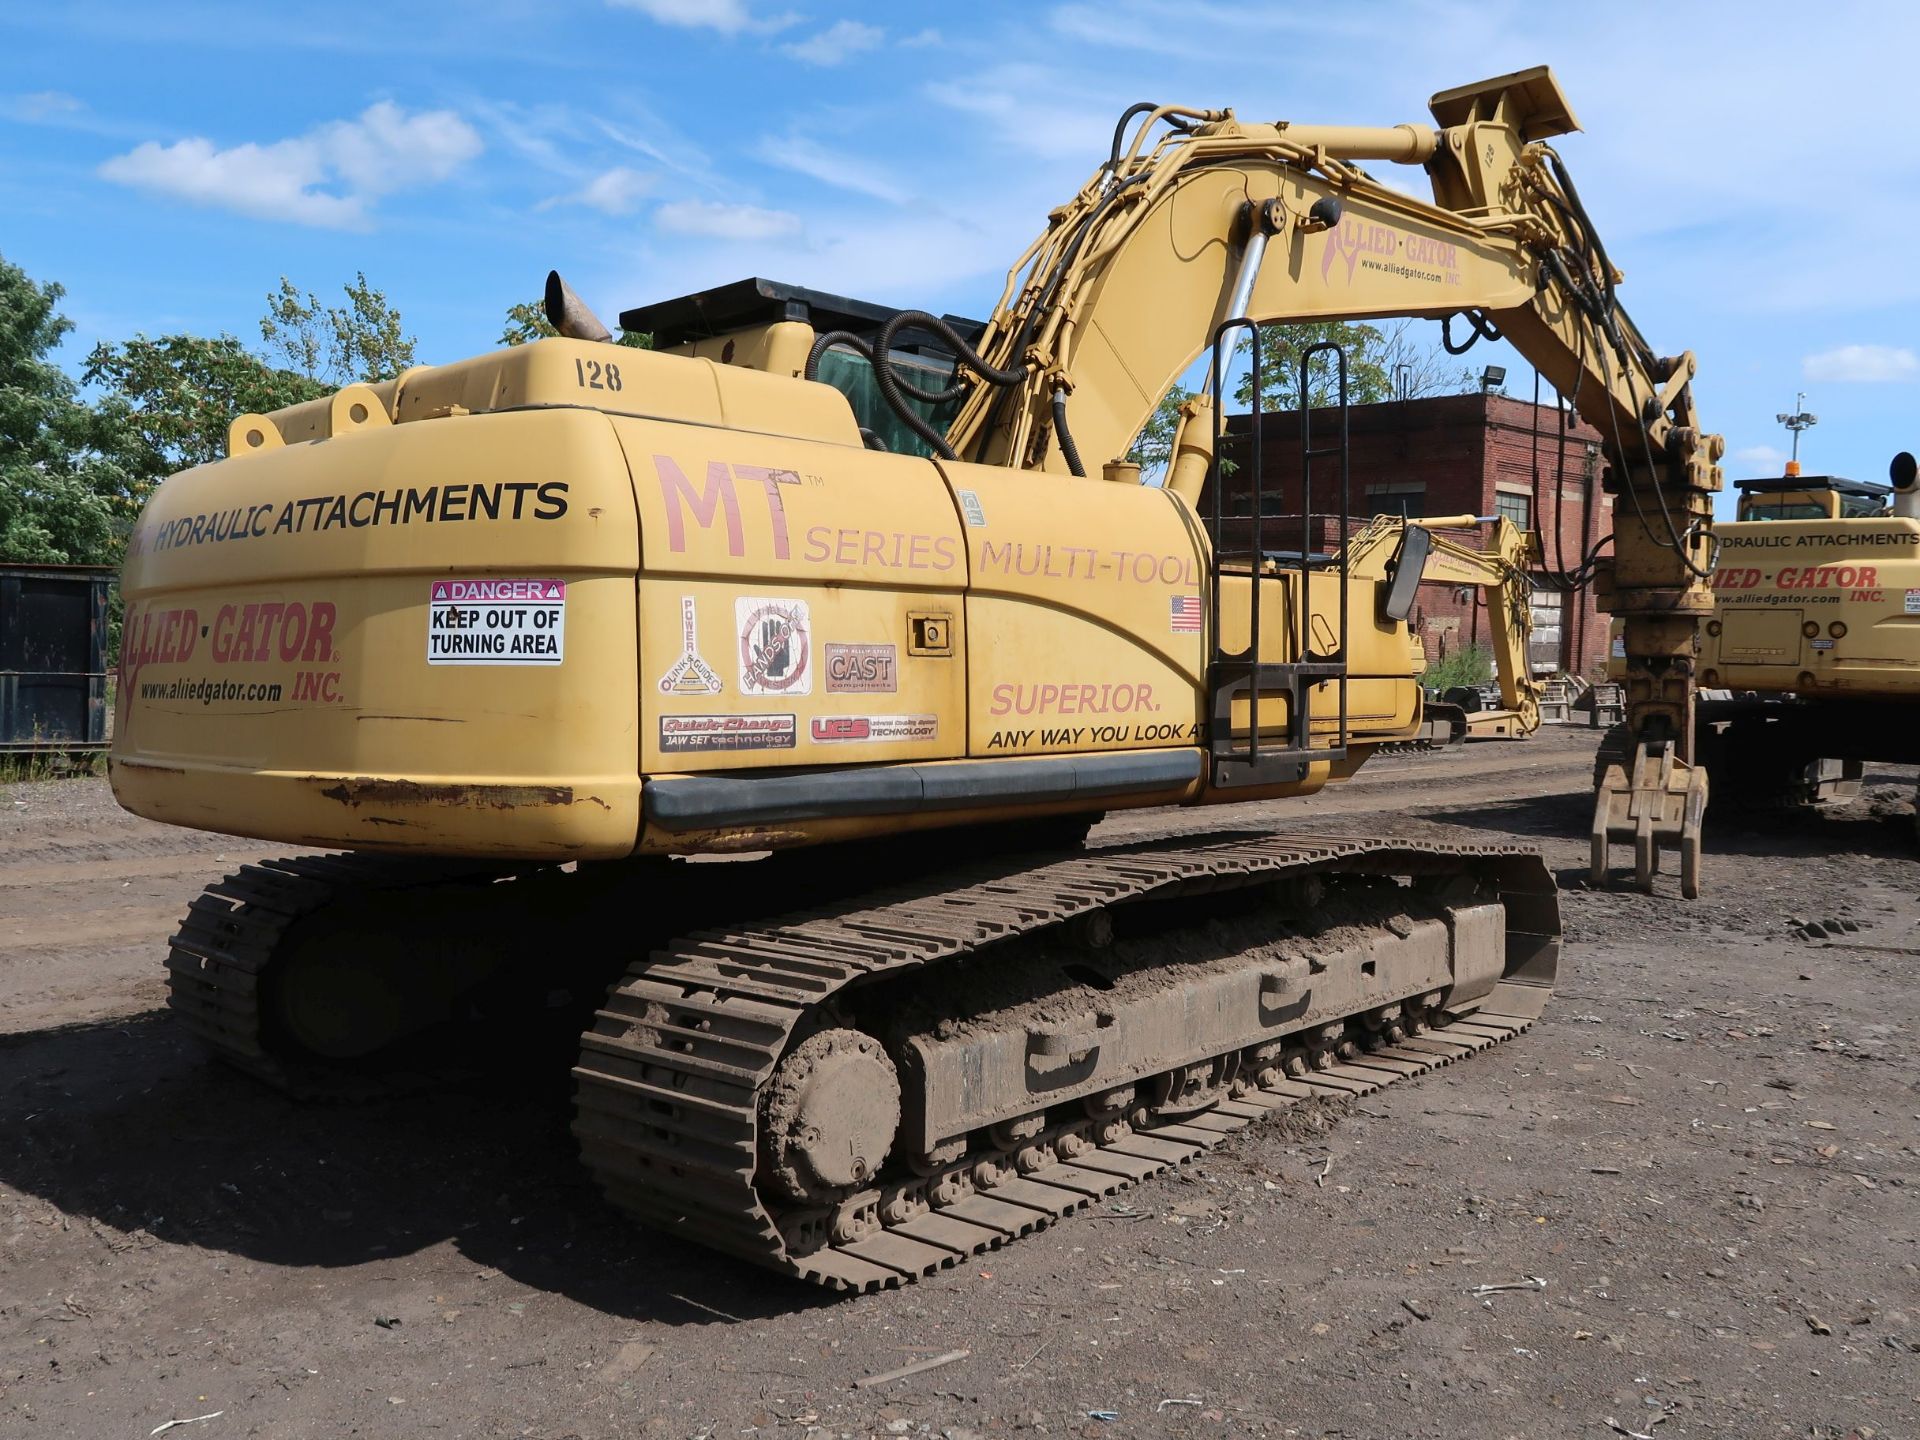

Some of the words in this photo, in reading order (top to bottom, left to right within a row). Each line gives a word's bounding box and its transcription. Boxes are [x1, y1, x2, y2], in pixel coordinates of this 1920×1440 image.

[1361, 258, 1442, 284] www.alliedgator.com
[576, 358, 622, 391] 128
[152, 503, 273, 552] HYDRAULIC
[272, 481, 569, 535] ATTACHMENTS
[652, 454, 801, 560] MT
[1720, 536, 1791, 548] DRAULIC
[1796, 533, 1919, 547] ATTACHMENTS
[804, 526, 957, 571] SERIES
[979, 540, 1201, 587] MULTI-TOOL
[1776, 567, 1877, 589] GATOR
[451, 582, 543, 600] DANGER
[1715, 594, 1840, 605] ww.alliedgator.com
[1850, 590, 1886, 602] INC.
[432, 610, 480, 629] KEEP
[486, 610, 527, 629] OUT
[533, 610, 560, 628] OF
[684, 600, 694, 651] POWER
[431, 634, 505, 654] TURNING
[510, 634, 558, 654] AREA
[667, 658, 689, 683] LINK
[693, 659, 715, 684] GUIDE
[830, 655, 892, 680] CAST
[141, 678, 282, 705] www.alliedgator.com
[291, 671, 344, 702] INC.
[990, 683, 1161, 716] SUPERIOR.
[663, 718, 793, 733] Quick-Change
[812, 719, 869, 739] UCS
[872, 727, 935, 736] TECHNOLOGY
[987, 730, 1034, 749] ANY
[1041, 727, 1085, 745] WAY
[1090, 725, 1130, 742] YOU
[1134, 723, 1185, 741] LOOK
[665, 736, 688, 745] JAW
[689, 735, 710, 744] SET
[711, 734, 791, 744] technology
